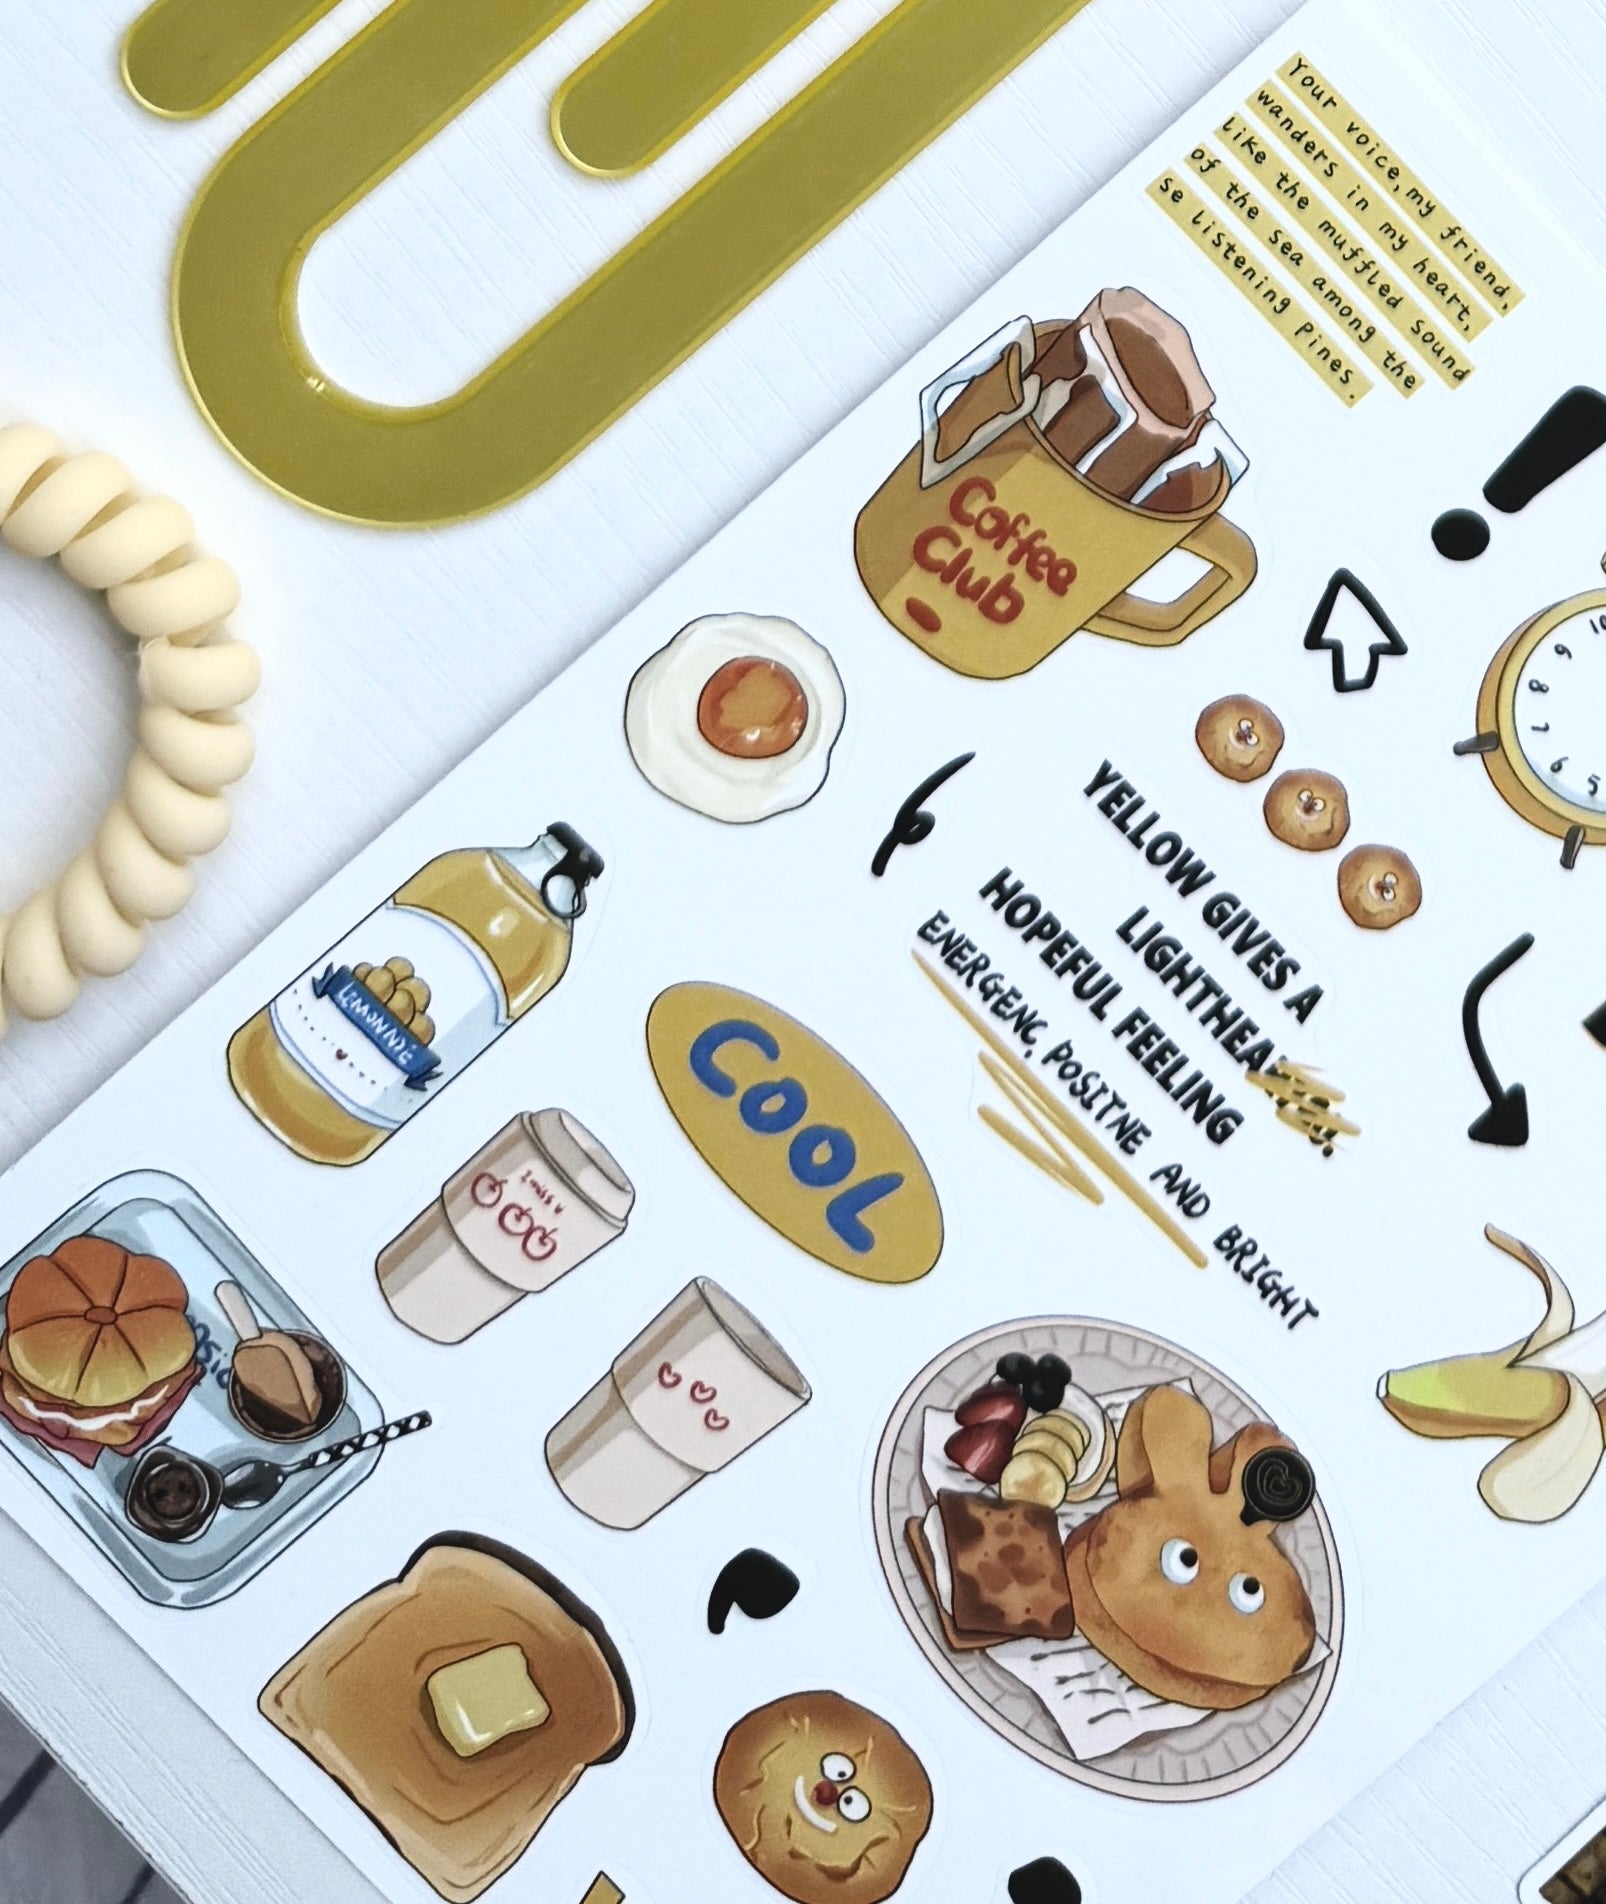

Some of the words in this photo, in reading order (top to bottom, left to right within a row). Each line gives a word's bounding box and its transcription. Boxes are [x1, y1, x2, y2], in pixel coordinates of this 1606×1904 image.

[1158, 176, 1185, 204] se
[1190, 147, 1222, 174] of
[1225, 181, 1260, 221] the
[1267, 228, 1305, 268] sea
[1311, 276, 1377, 344] among
[1382, 349, 1417, 390] the
[1256, 89, 1339, 179] wanders
[1346, 184, 1370, 212] in
[1378, 221, 1409, 253] my
[1412, 257, 1471, 333] heart,
[1275, 171, 1310, 211] the
[1317, 219, 1405, 310] muffled
[1409, 318, 1471, 382] sound
[1288, 56, 1338, 109] Your
[1439, 225, 1511, 311] friend,
[912, 525, 1026, 625] Club
[948, 475, 1079, 597] Coffee
[977, 867, 1124, 1023] HOPEFUL
[1110, 1006, 1245, 1147] FEELING
[1082, 759, 1217, 899] YELLOW
[1201, 892, 1302, 993] GIVES
[1282, 984, 1325, 1026] A
[688, 1017, 907, 1255] COOL
[1148, 1163, 1212, 1220] AND
[1212, 1224, 1320, 1331] BRIGHT
